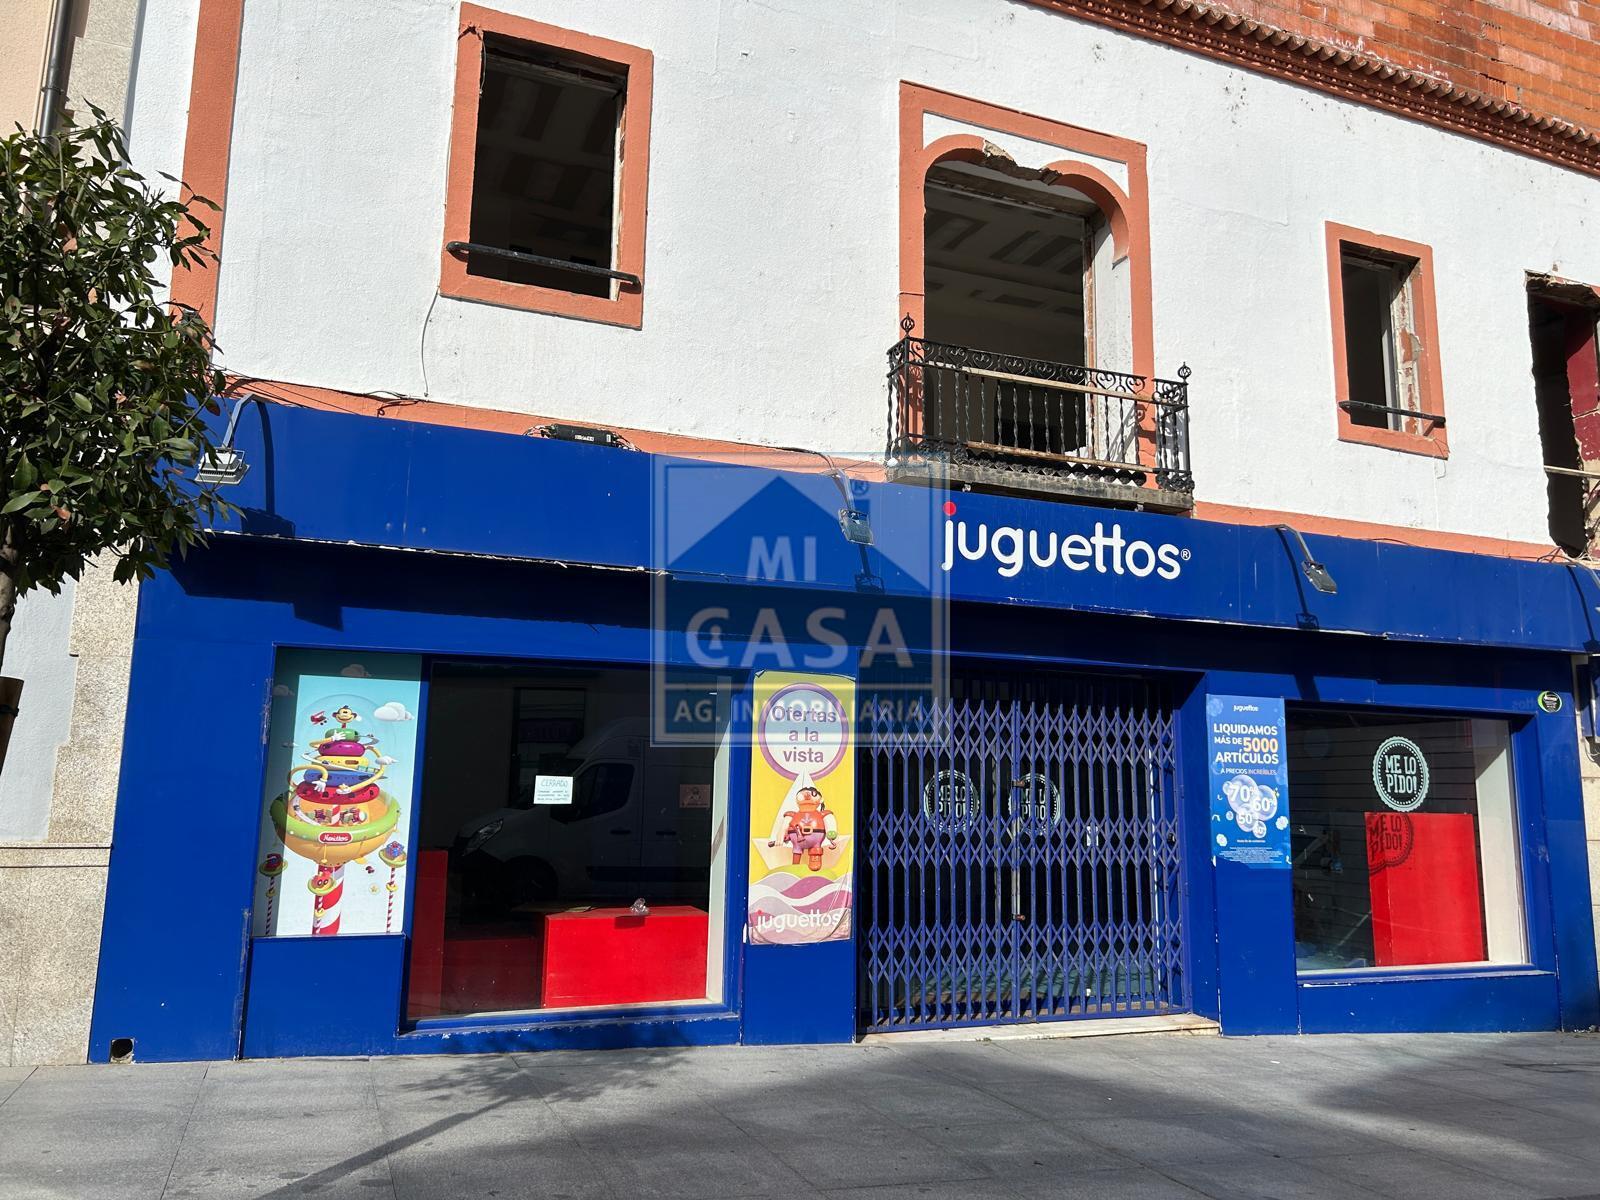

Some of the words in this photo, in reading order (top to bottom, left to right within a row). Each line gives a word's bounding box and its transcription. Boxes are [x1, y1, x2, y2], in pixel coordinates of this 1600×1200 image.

[771, 705, 836, 724] Ofertas
[788, 731, 801, 742] a
[804, 727, 819, 742] la
[1213, 723, 1278, 736] LIQUIDAMOS
[1214, 735, 1231, 745] MÁS
[1243, 737, 1279, 753] 5000
[783, 747, 824, 763] vista
[1215, 749, 1279, 764] ARTÍCULOS
[1384, 755, 1402, 773] ME
[1403, 756, 1417, 775] LO
[1386, 774, 1417, 794] PIDO!
[756, 907, 841, 934] juguettos
